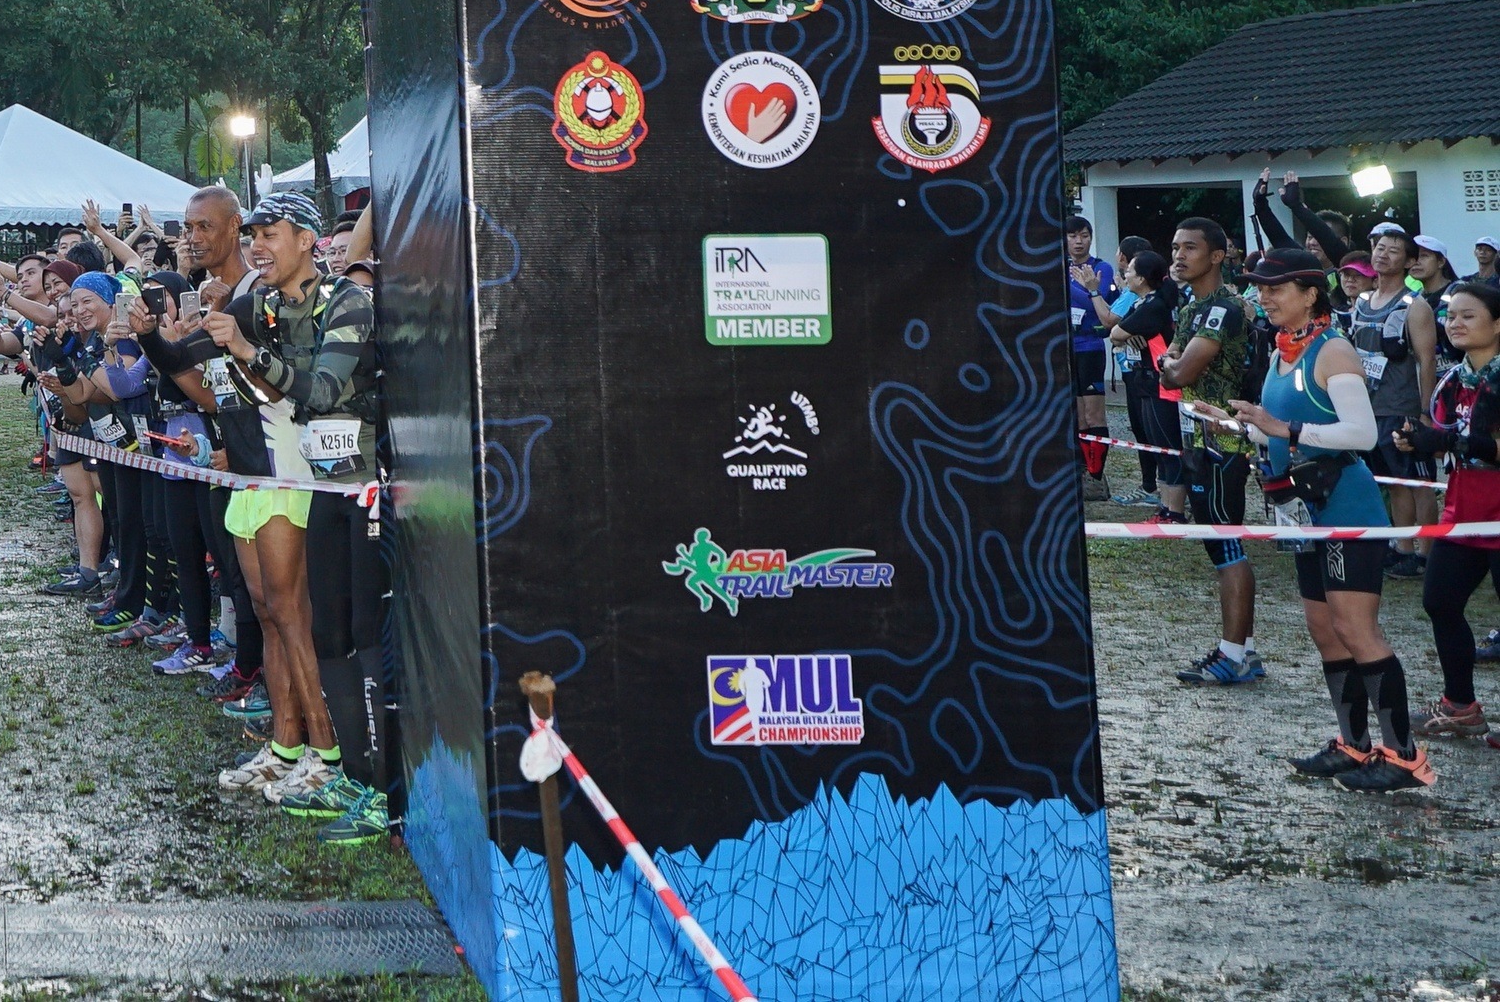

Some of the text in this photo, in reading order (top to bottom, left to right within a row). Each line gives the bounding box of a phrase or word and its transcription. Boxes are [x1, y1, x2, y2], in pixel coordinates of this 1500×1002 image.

[900, 7, 933, 19] DIRAJA
[709, 57, 810, 98] Kami Sedia Membantu
[708, 112, 816, 164] KEMENTERIAN KESIHATAN MALAYSIA
[717, 303, 771, 311] ASSOCIATION
[716, 318, 821, 338] MEMBER
[790, 390, 819, 429] UTMB
[320, 434, 354, 450] K2516
[726, 464, 807, 477] QUALIFYING
[753, 478, 787, 490] RACE
[726, 551, 786, 573] ASIA
[755, 658, 860, 713] MUL
[759, 715, 861, 725] MALAYSIA ULTRA LEAGUE
[759, 727, 862, 741] CHAMPIONSHIP
